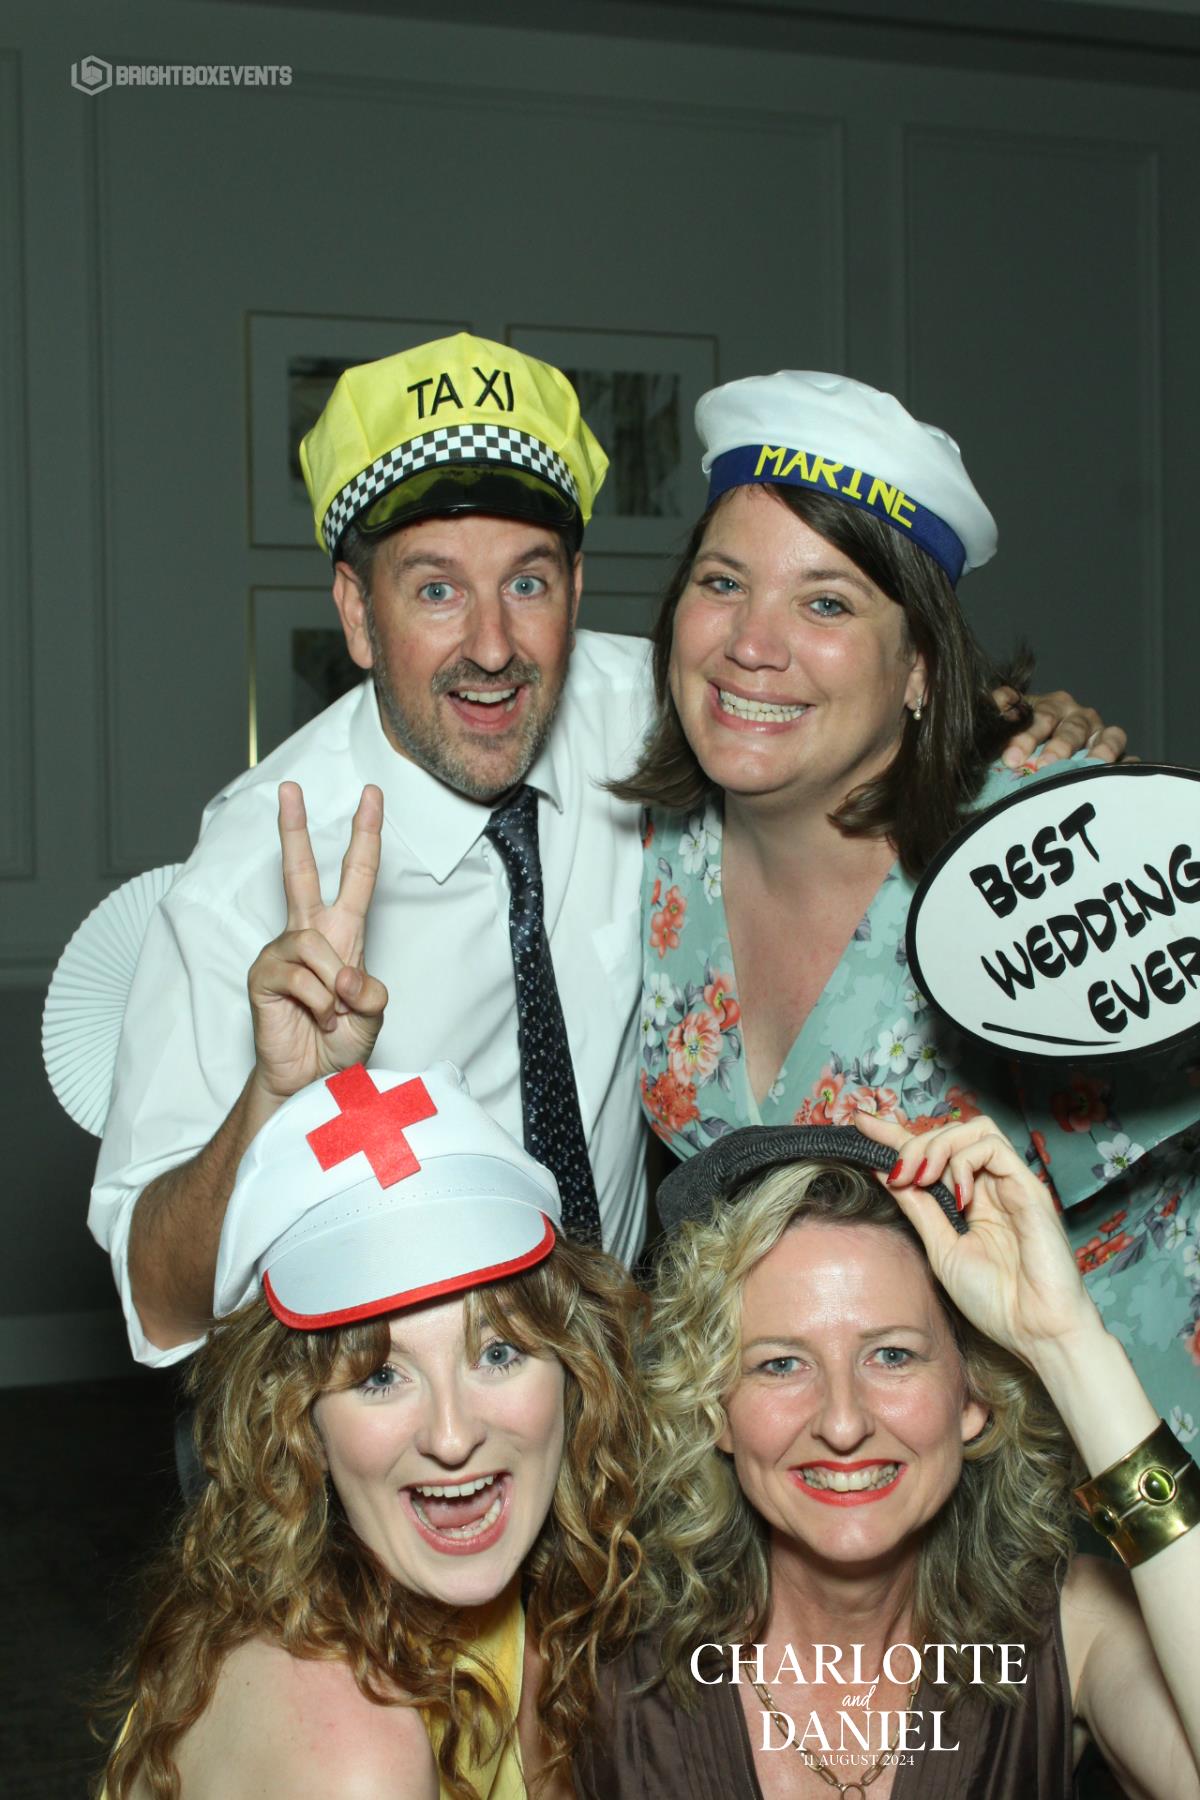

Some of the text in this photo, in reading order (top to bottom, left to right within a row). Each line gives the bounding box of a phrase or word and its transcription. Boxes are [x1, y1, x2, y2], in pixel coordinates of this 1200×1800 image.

[407, 366, 514, 419] TAXI
[754, 444, 917, 529] MARINE
[969, 802, 1100, 919] BEST
[980, 843, 1200, 1001] WEDDING
